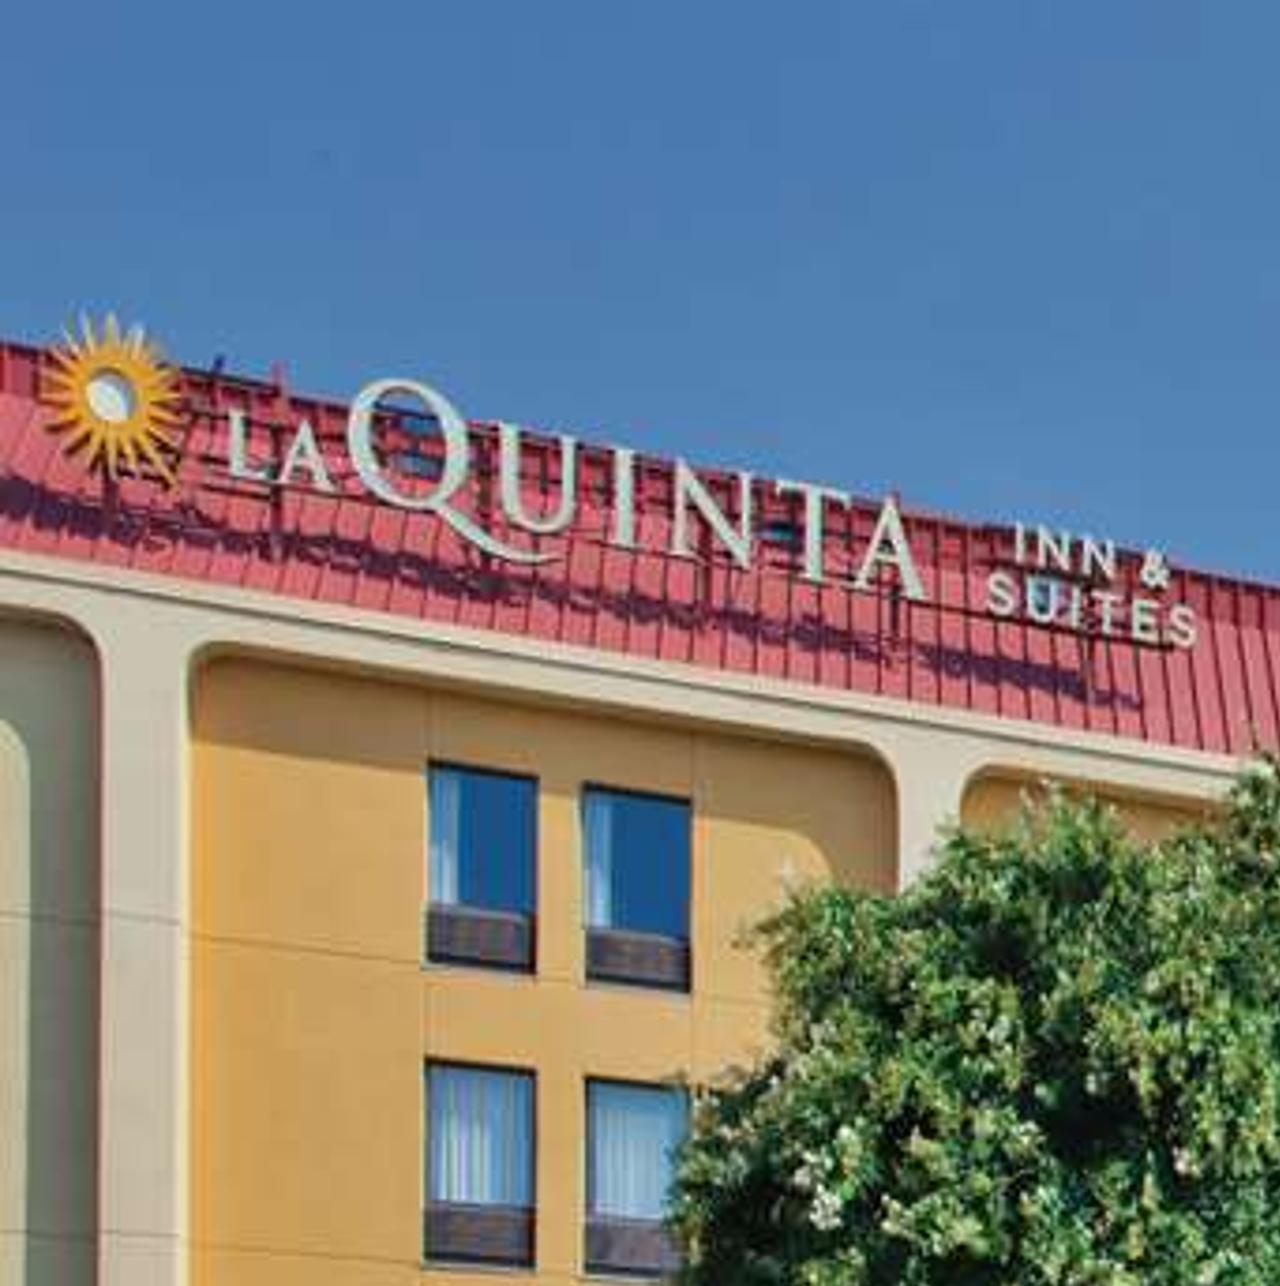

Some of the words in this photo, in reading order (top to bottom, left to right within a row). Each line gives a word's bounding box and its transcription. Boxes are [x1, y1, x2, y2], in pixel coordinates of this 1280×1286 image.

[228, 408, 339, 492] LA
[348, 378, 926, 600] QUINTA
[1014, 520, 1117, 581] INN
[1140, 549, 1171, 590] &
[986, 568, 1199, 648] SUITES
